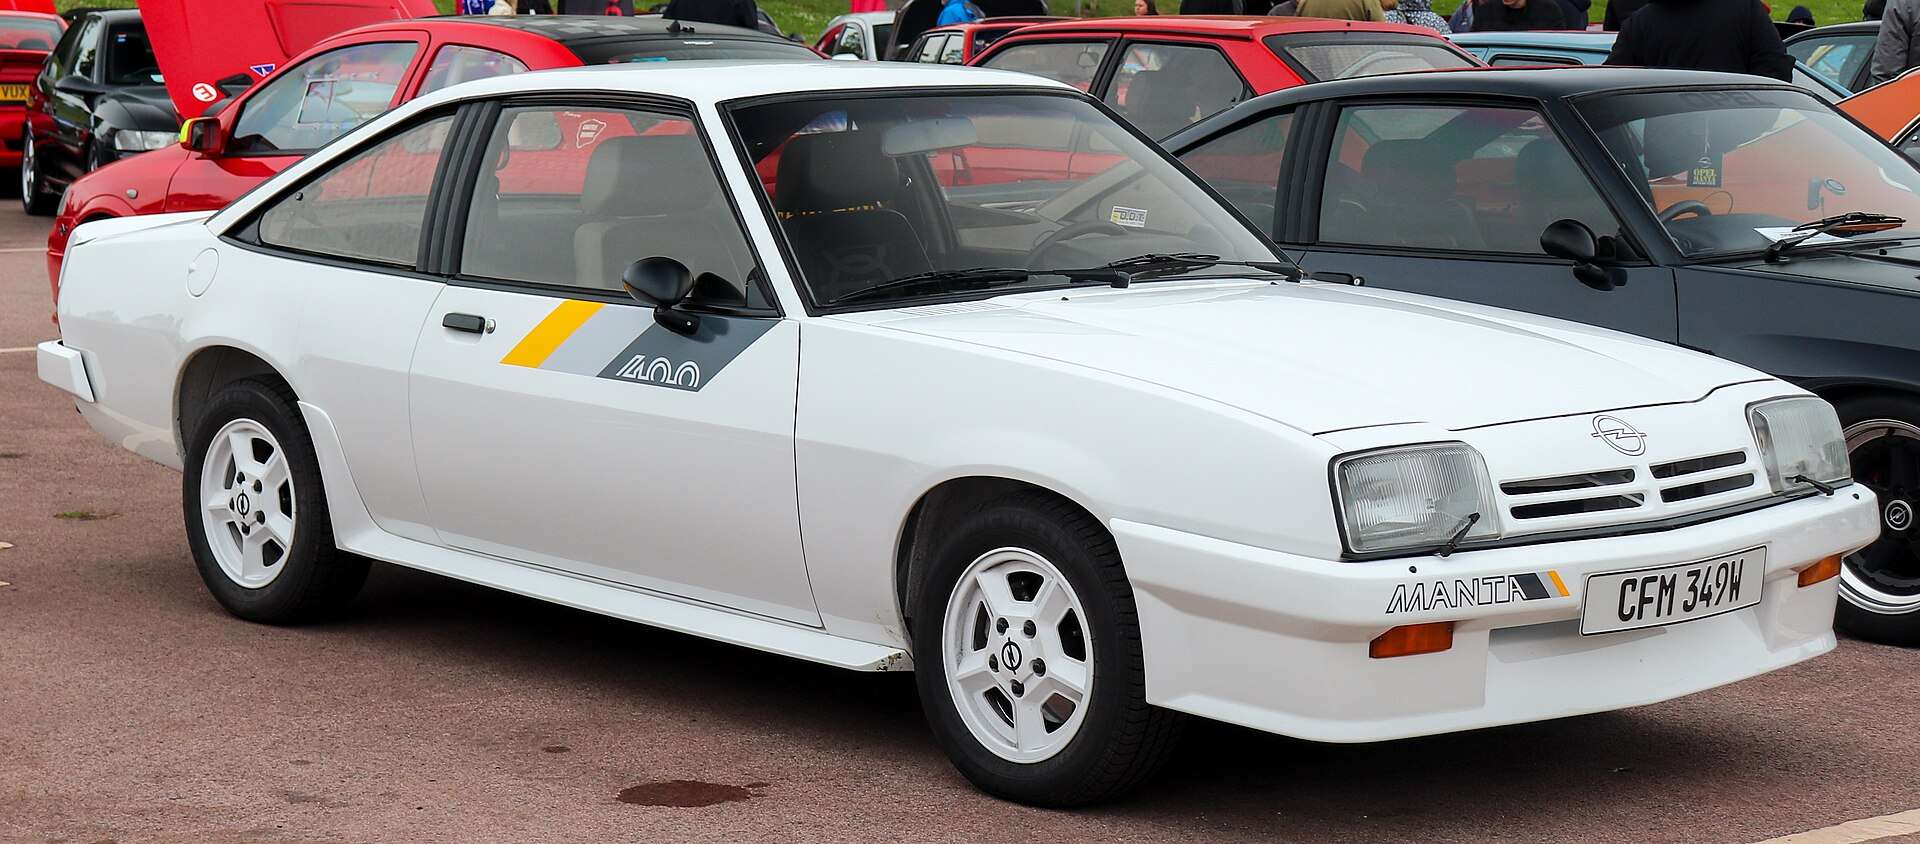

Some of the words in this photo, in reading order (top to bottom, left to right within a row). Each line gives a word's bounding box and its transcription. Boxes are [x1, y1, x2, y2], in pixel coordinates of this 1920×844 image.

[1, 86, 27, 98] VUX
[615, 353, 701, 388] 400
[1385, 574, 1529, 614] MANTA
[1617, 573, 1678, 622] CFM
[1682, 558, 1744, 613] 349W
